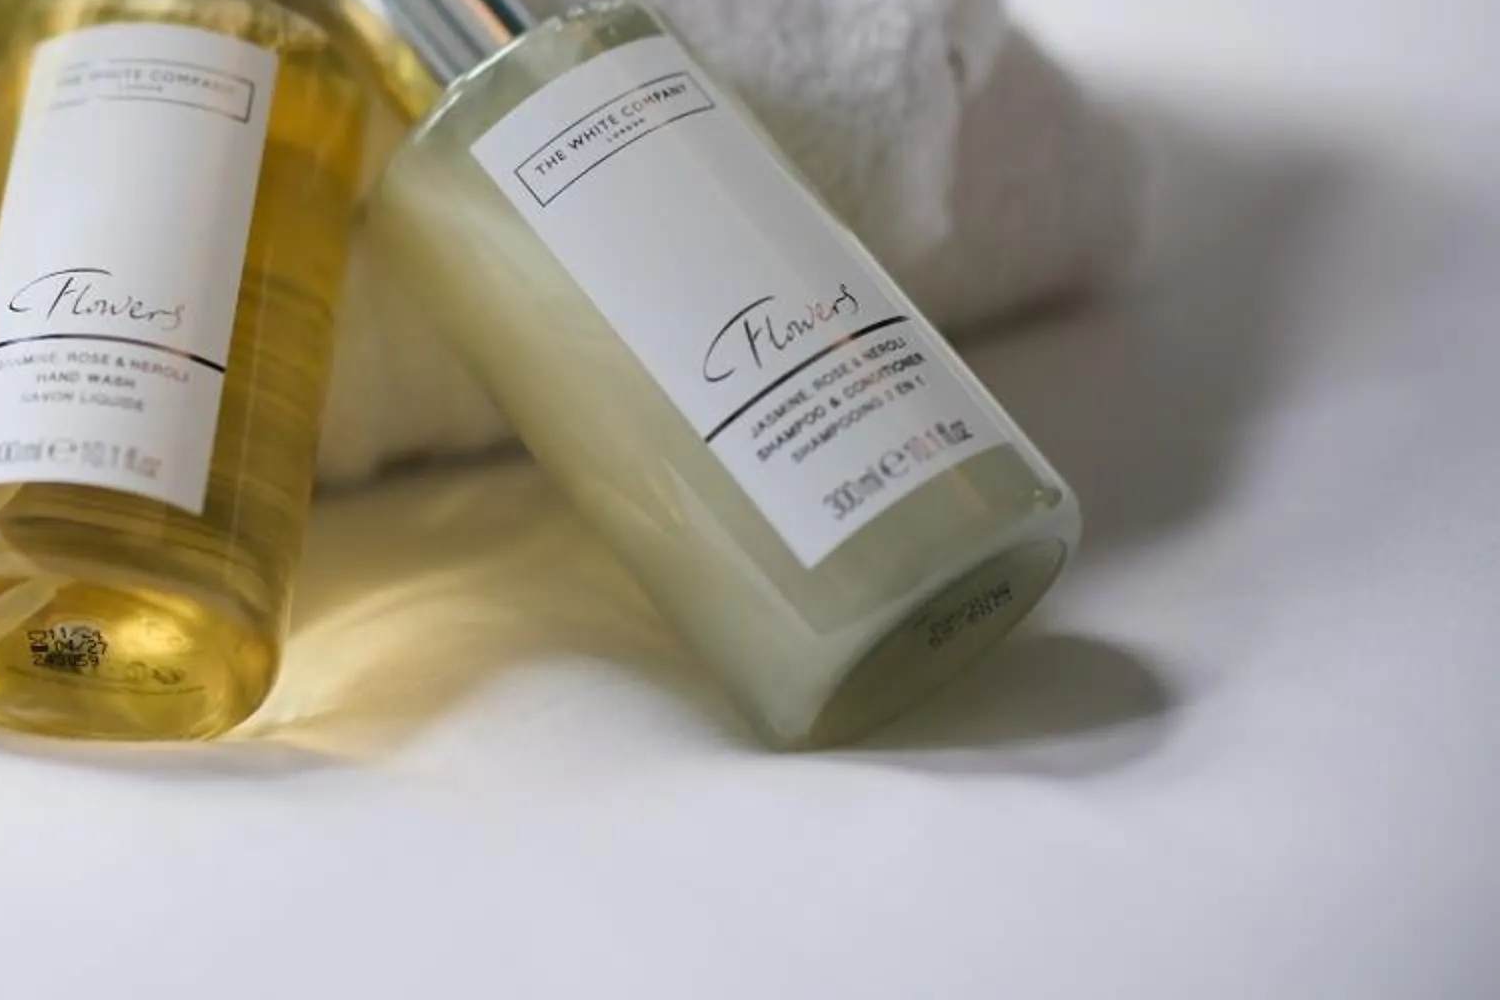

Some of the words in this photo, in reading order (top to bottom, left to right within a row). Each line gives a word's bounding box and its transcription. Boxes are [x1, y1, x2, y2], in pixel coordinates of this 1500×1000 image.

[534, 149, 568, 176] THE
[567, 113, 619, 150] WHITE
[620, 83, 688, 119] COMPANY
[8, 266, 186, 331] Flowers
[66, 351, 110, 366] ROSE
[115, 356, 126, 369] &
[702, 284, 859, 383] Flowers
[36, 371, 80, 385] HAND
[87, 374, 137, 390] WASH
[756, 405, 828, 462] SHAMPOO
[828, 396, 841, 410] &
[842, 352, 928, 400] CONDITIONER
[812, 362, 853, 390] ROSE
[791, 396, 885, 464] SHAMPOOING
